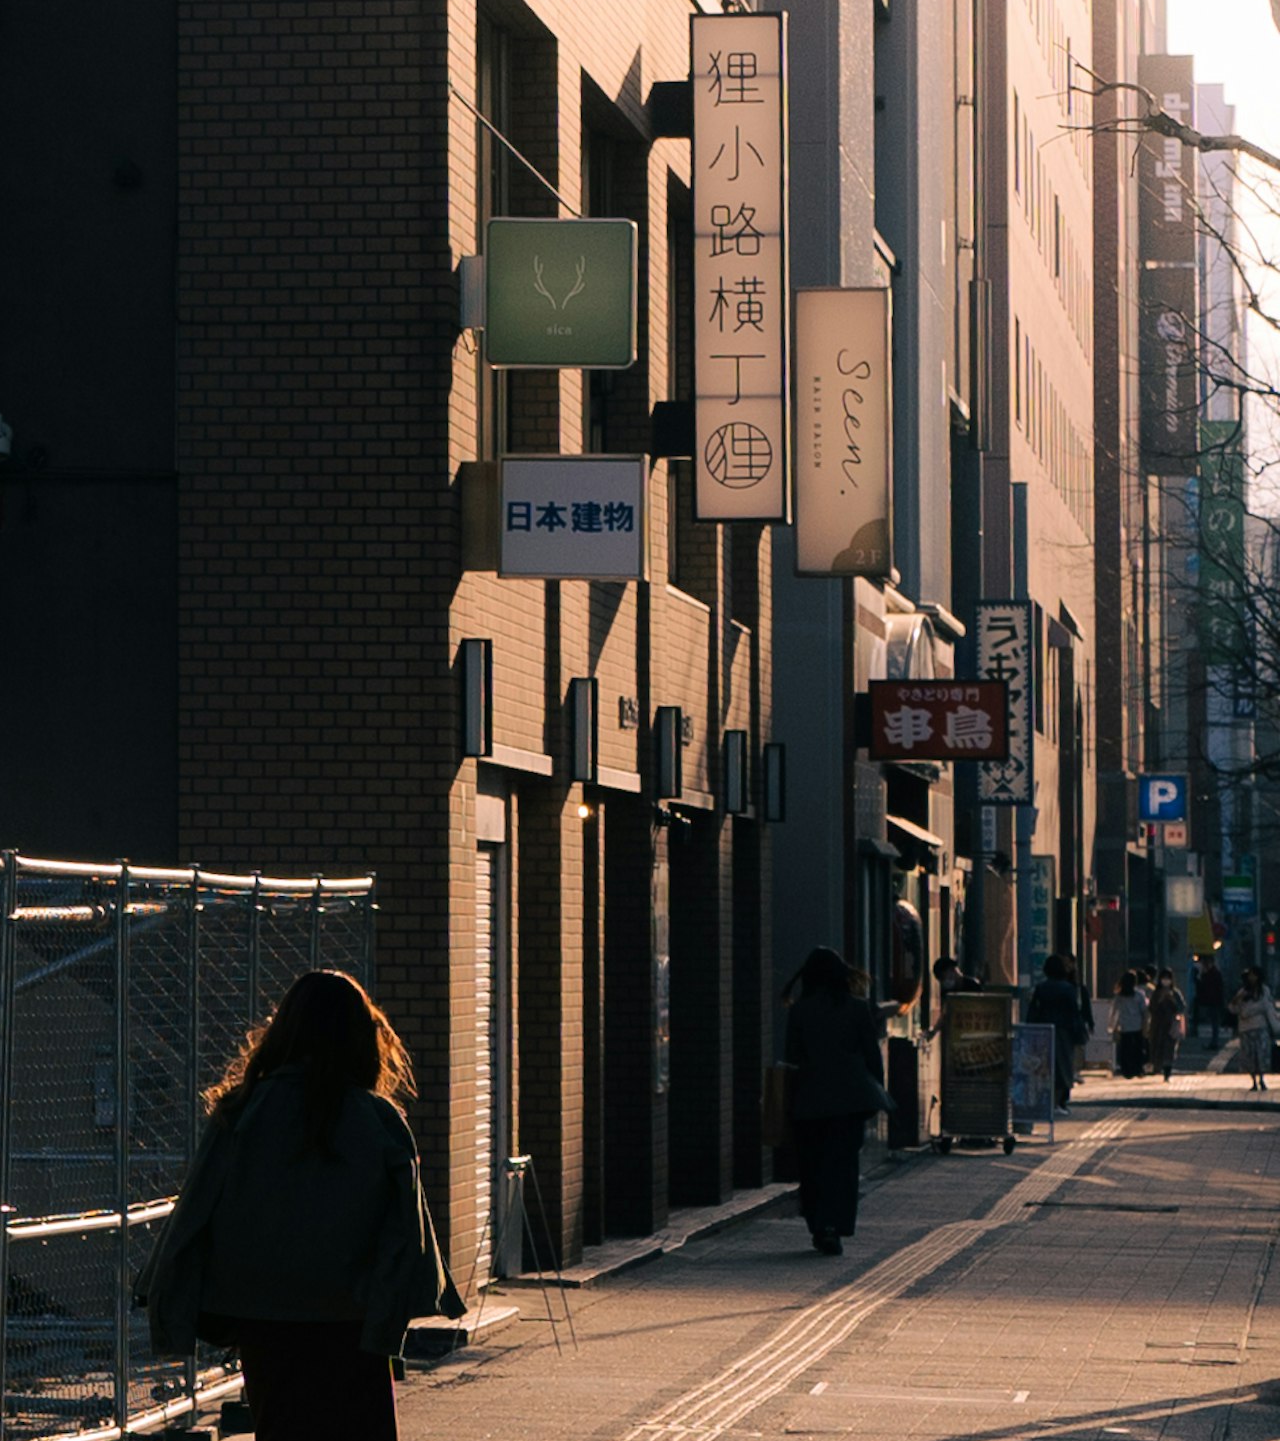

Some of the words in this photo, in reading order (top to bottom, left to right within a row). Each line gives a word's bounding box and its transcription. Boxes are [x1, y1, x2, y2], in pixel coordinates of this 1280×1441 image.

[707, 50, 767, 406] 狸小路横丁
[505, 500, 635, 533] 日本建物
[896, 687, 981, 703] やきとり専門
[882, 704, 994, 751] 串鳥
[1148, 779, 1178, 816] P
